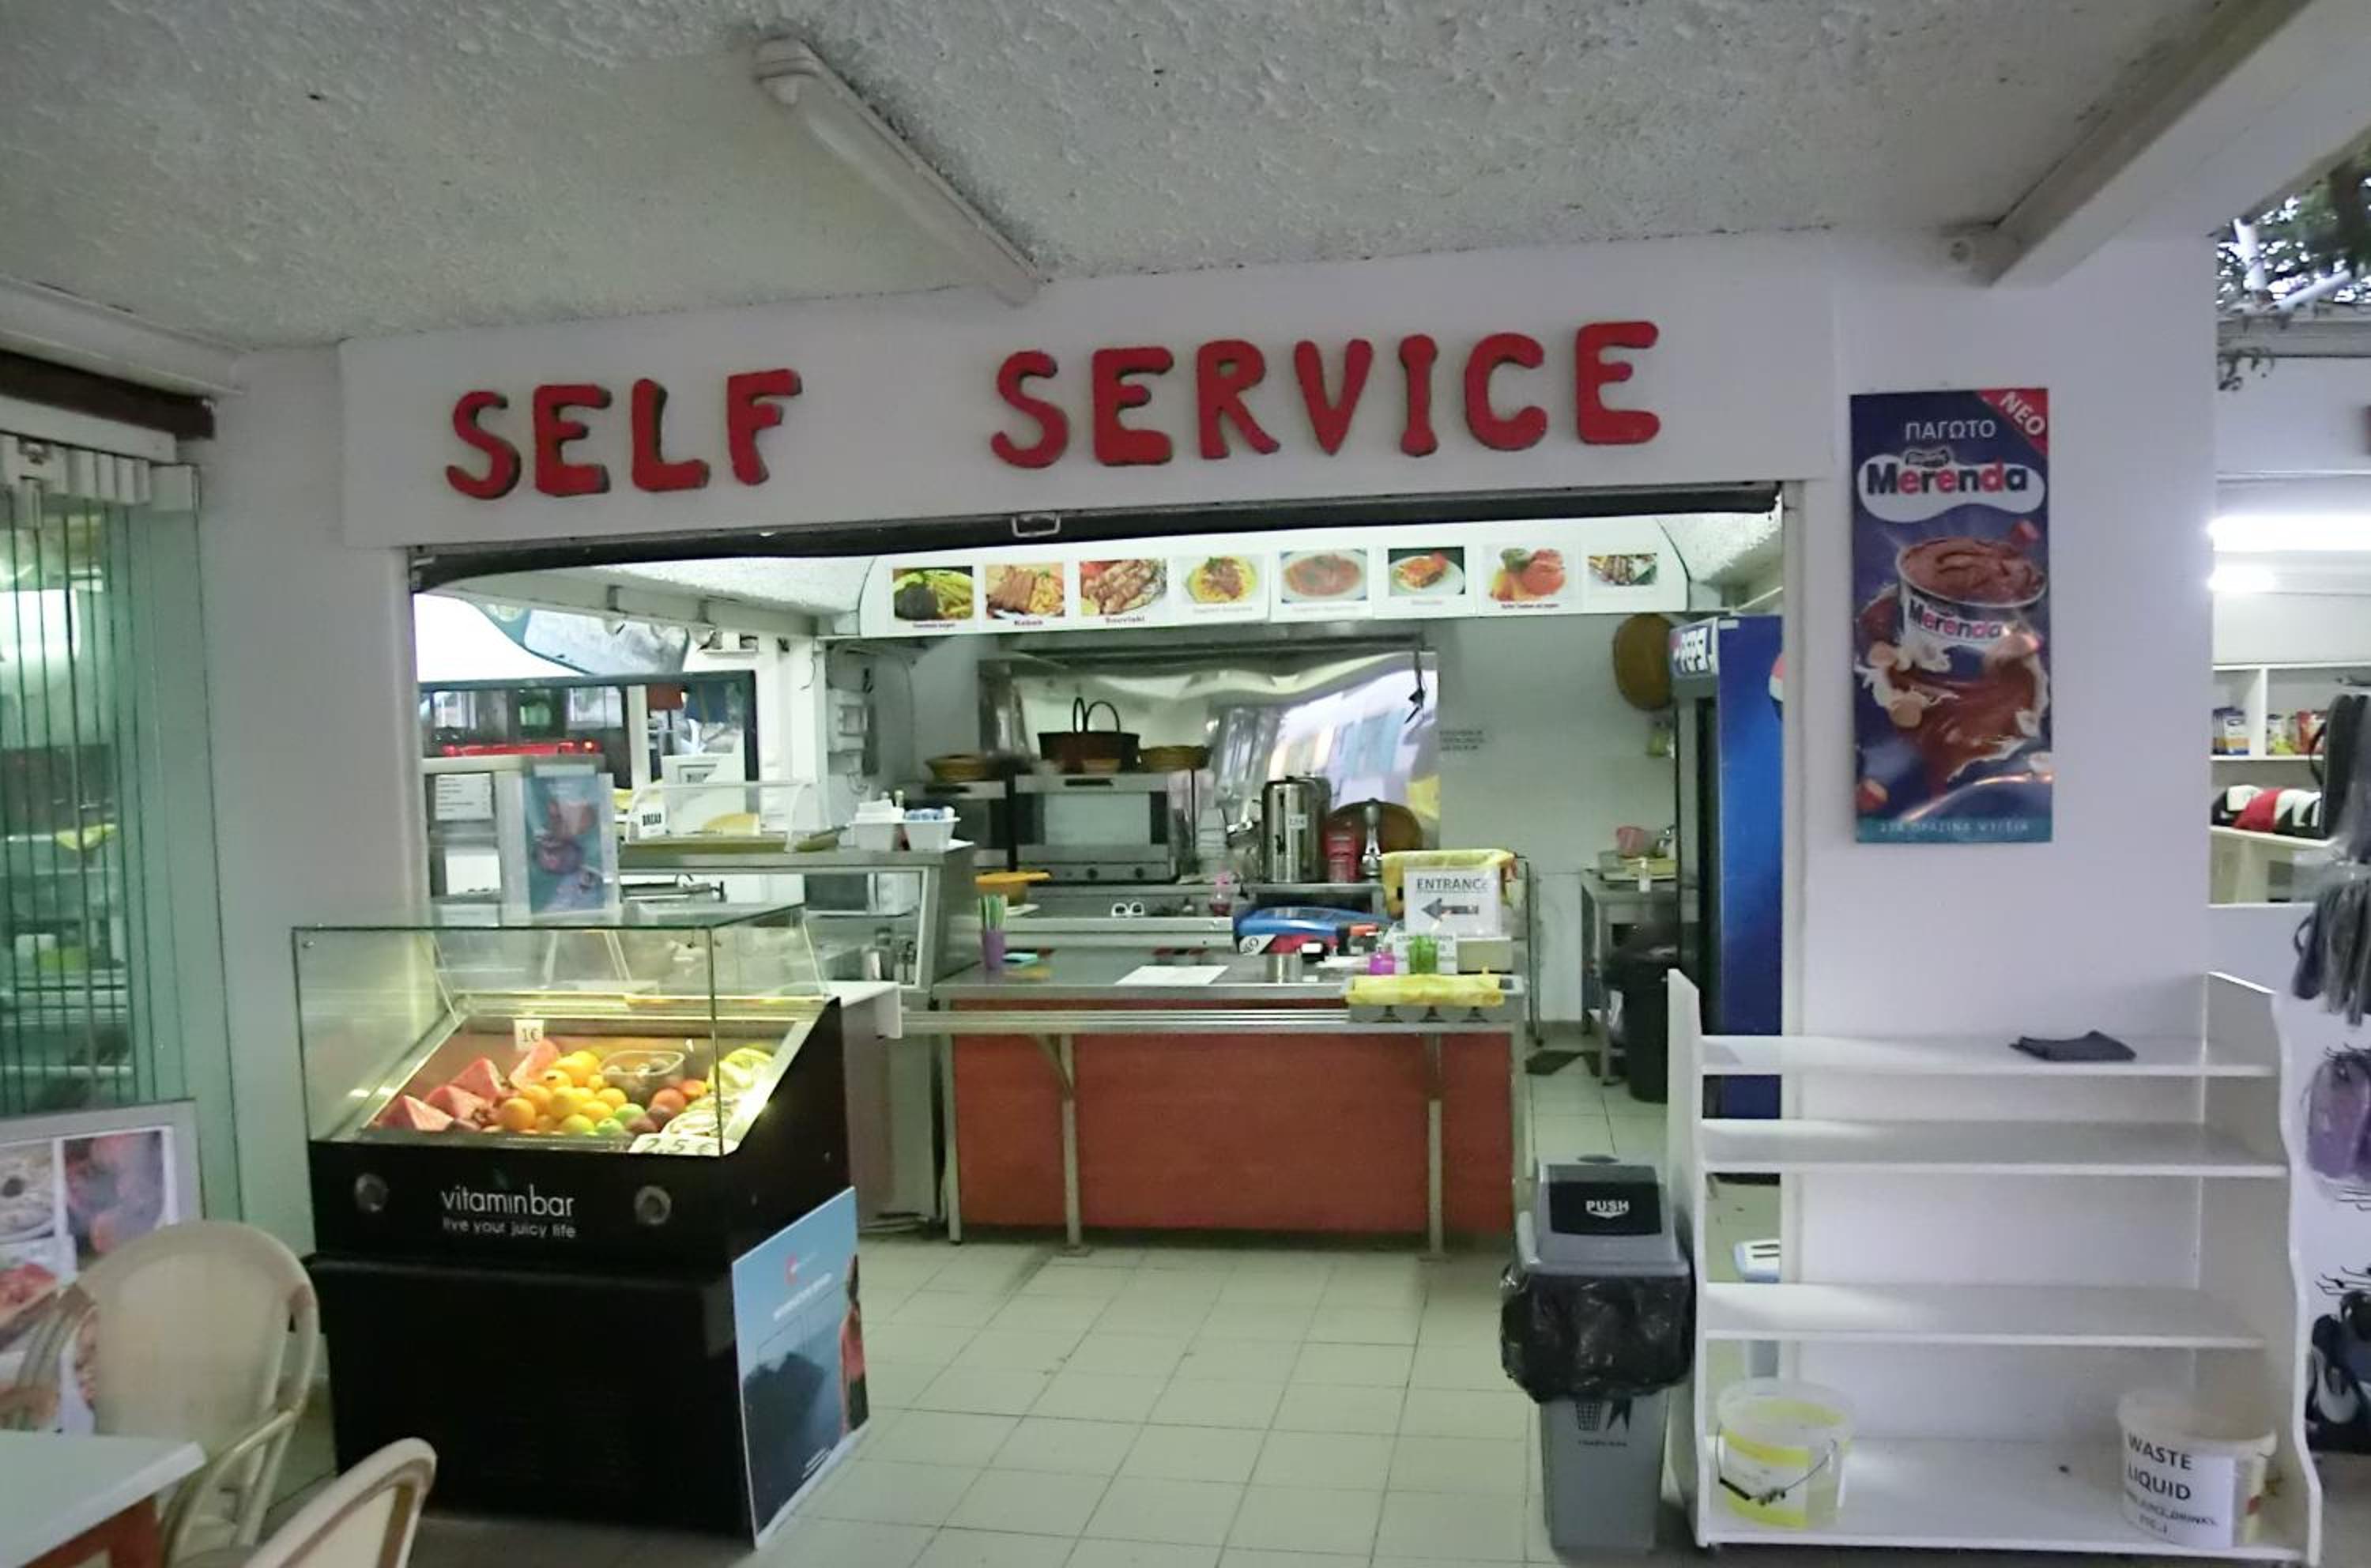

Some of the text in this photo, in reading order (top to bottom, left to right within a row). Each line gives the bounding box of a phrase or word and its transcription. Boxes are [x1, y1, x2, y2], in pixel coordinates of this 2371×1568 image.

[445, 321, 1661, 500] SELF SERVICE
[1905, 419, 1996, 440] ΠΑΓΩΤΟ
[1866, 456, 2028, 495] Merenda
[1585, 1200, 1630, 1212] PUSH
[473, 1220, 506, 1235] your
[511, 1221, 548, 1238] juicy
[552, 1223, 577, 1238] life
[2128, 1431, 2194, 1471] WASTE
[2128, 1461, 2192, 1501] LIQUID
